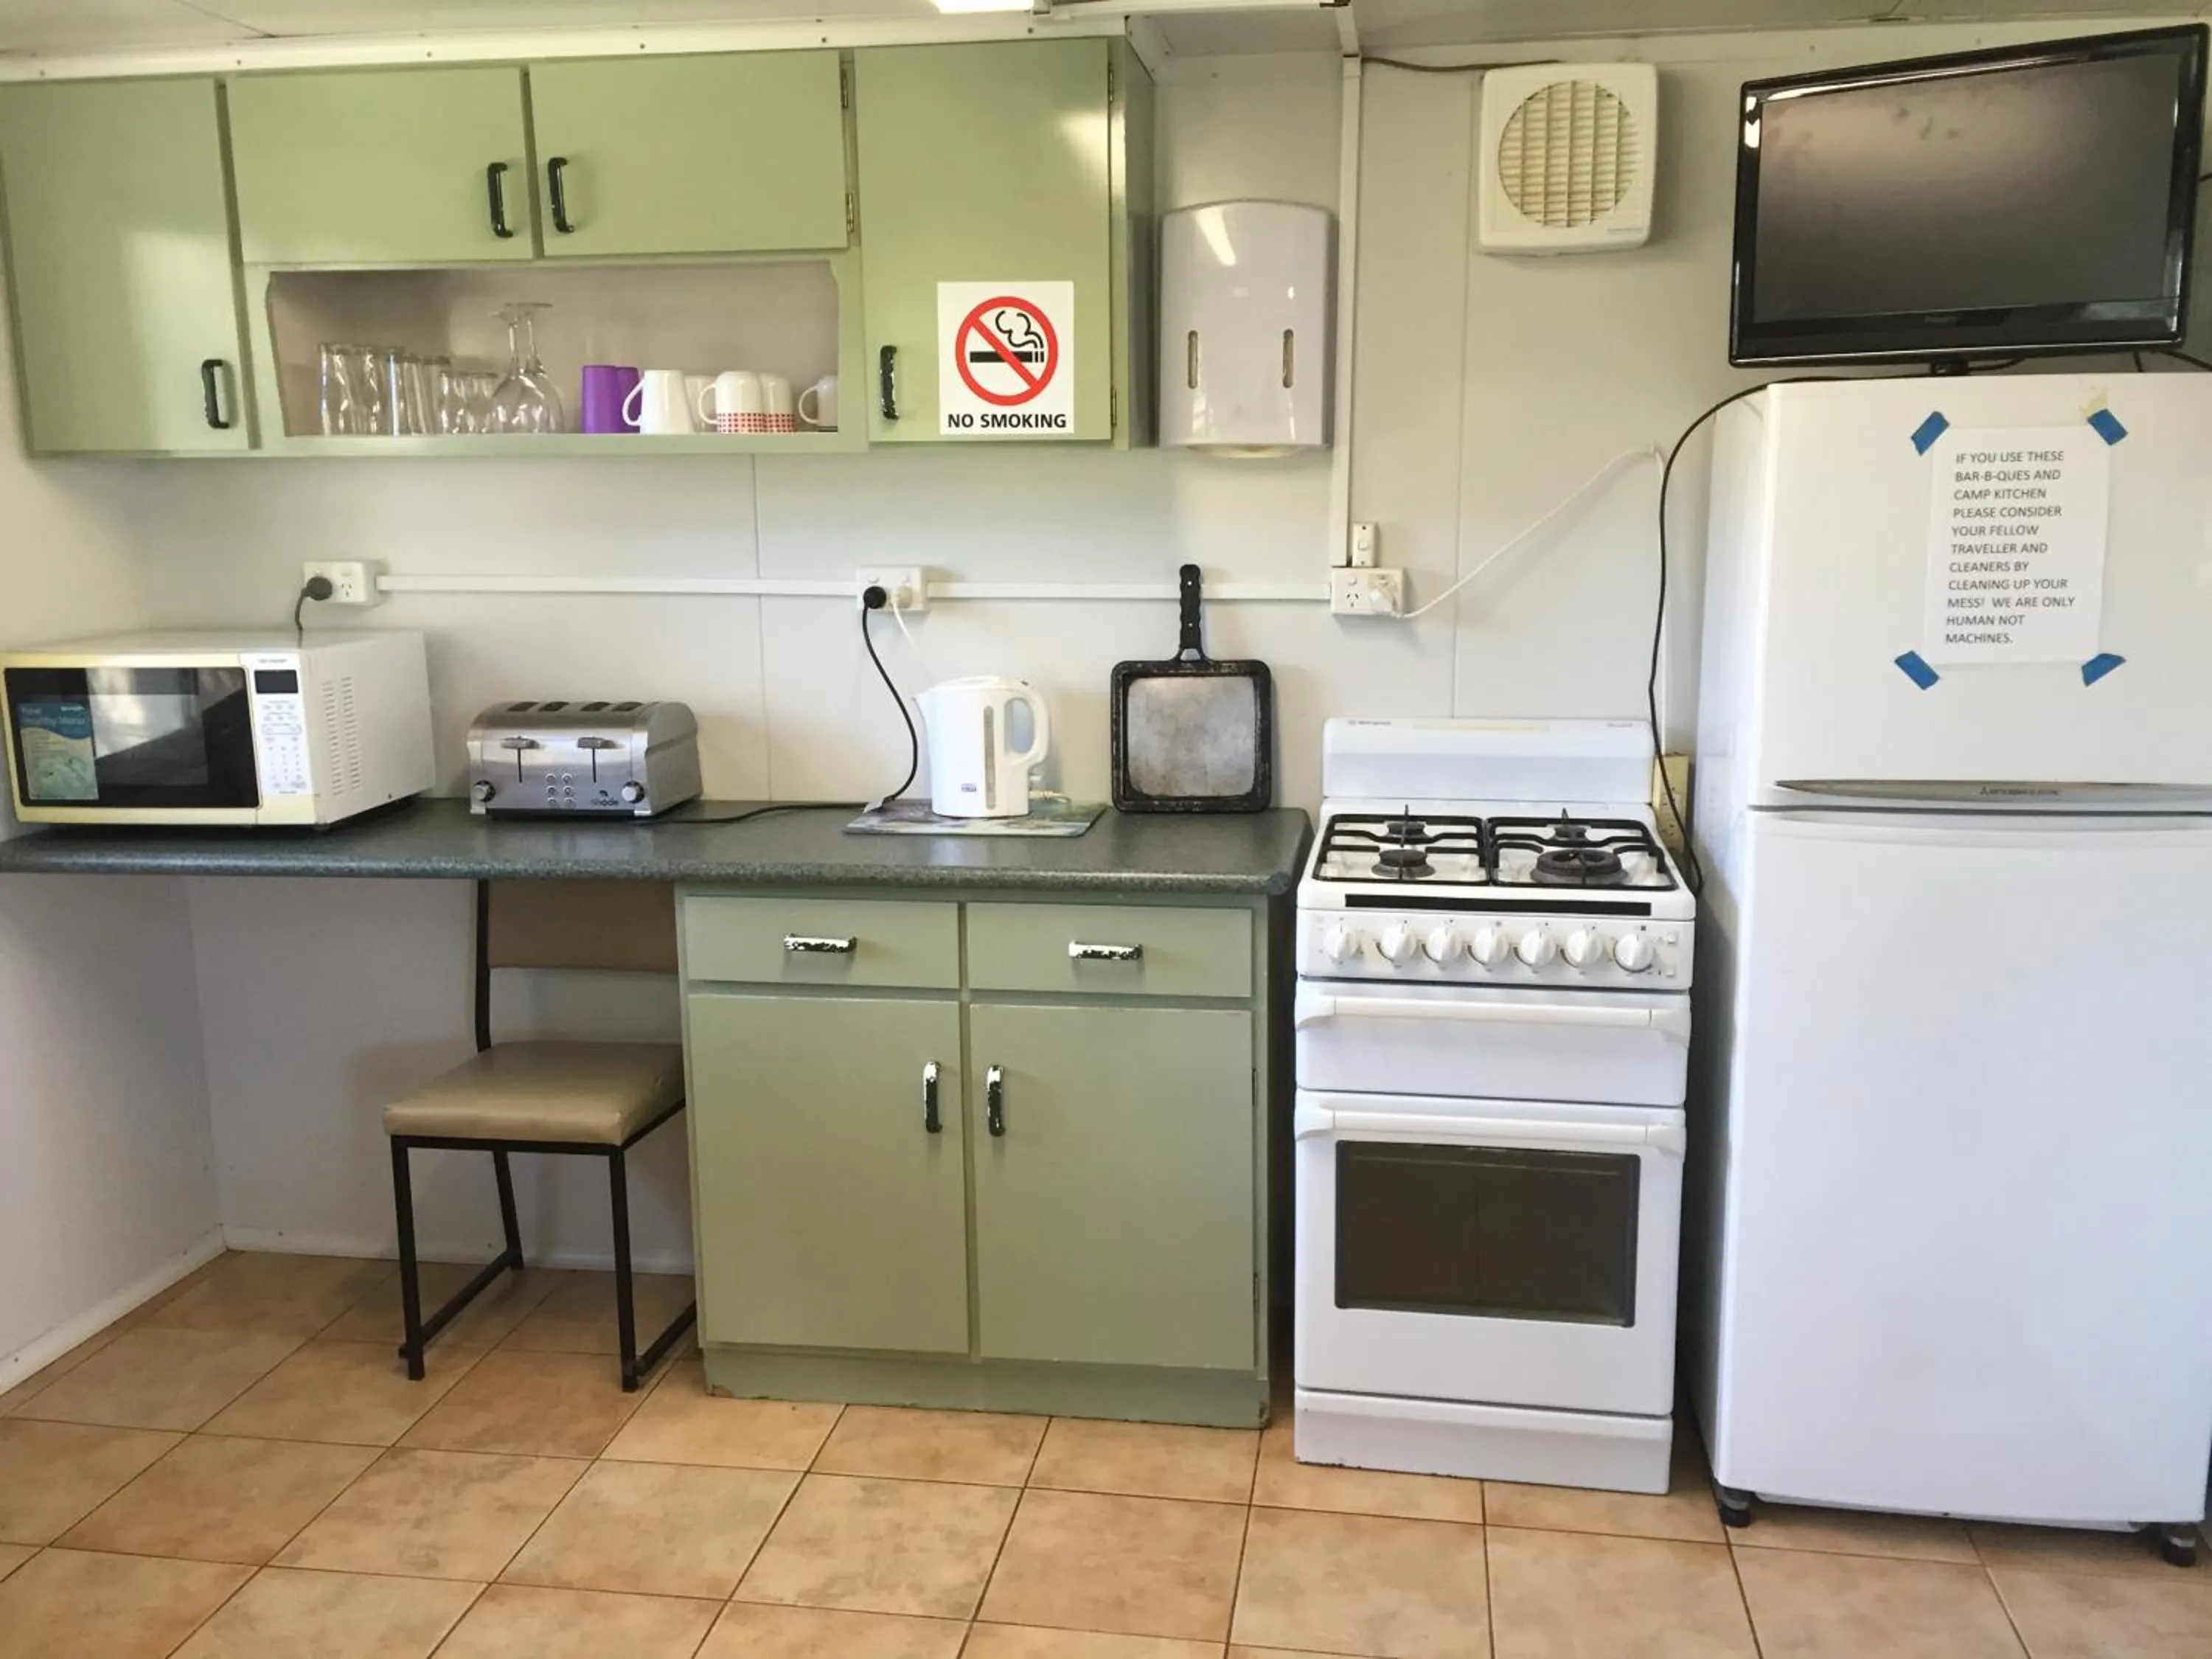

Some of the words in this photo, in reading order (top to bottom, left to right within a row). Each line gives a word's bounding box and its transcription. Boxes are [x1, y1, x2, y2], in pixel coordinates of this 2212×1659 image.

[947, 414, 974, 428] NO
[980, 414, 1066, 428] SMOKING
[1956, 453, 1966, 464] IF
[1970, 452, 1996, 463] YOU
[2000, 451, 2023, 462] USE
[2028, 451, 2065, 462] THESE
[1955, 470, 2030, 482] BAR-B-QUES
[2034, 469, 2061, 480] AND
[1954, 489, 1991, 500] CAMP
[1994, 487, 2047, 499] KITCHEN
[1953, 507, 1997, 518] PLEASE
[2000, 505, 2062, 518] CONSIDER
[1952, 526, 1986, 536] YOUR
[1990, 524, 2039, 536] FELLOW
[1951, 543, 2017, 554] TRAVELLER
[2020, 543, 2048, 553] AND
[1949, 562, 2011, 573] CLEANERS
[2014, 561, 2029, 571] BY
[1948, 580, 2010, 591] CLEANING
[2014, 579, 2031, 589] UP
[2034, 578, 2068, 589] YOUR
[1947, 598, 1984, 608] MESS!
[1992, 597, 2012, 608] WE
[2015, 597, 2039, 607] ARE
[2042, 597, 2076, 607] ONLY
[1946, 616, 1994, 625] HUMAN
[1998, 614, 2025, 625] NOT
[1946, 633, 2013, 644] MACHINES.
